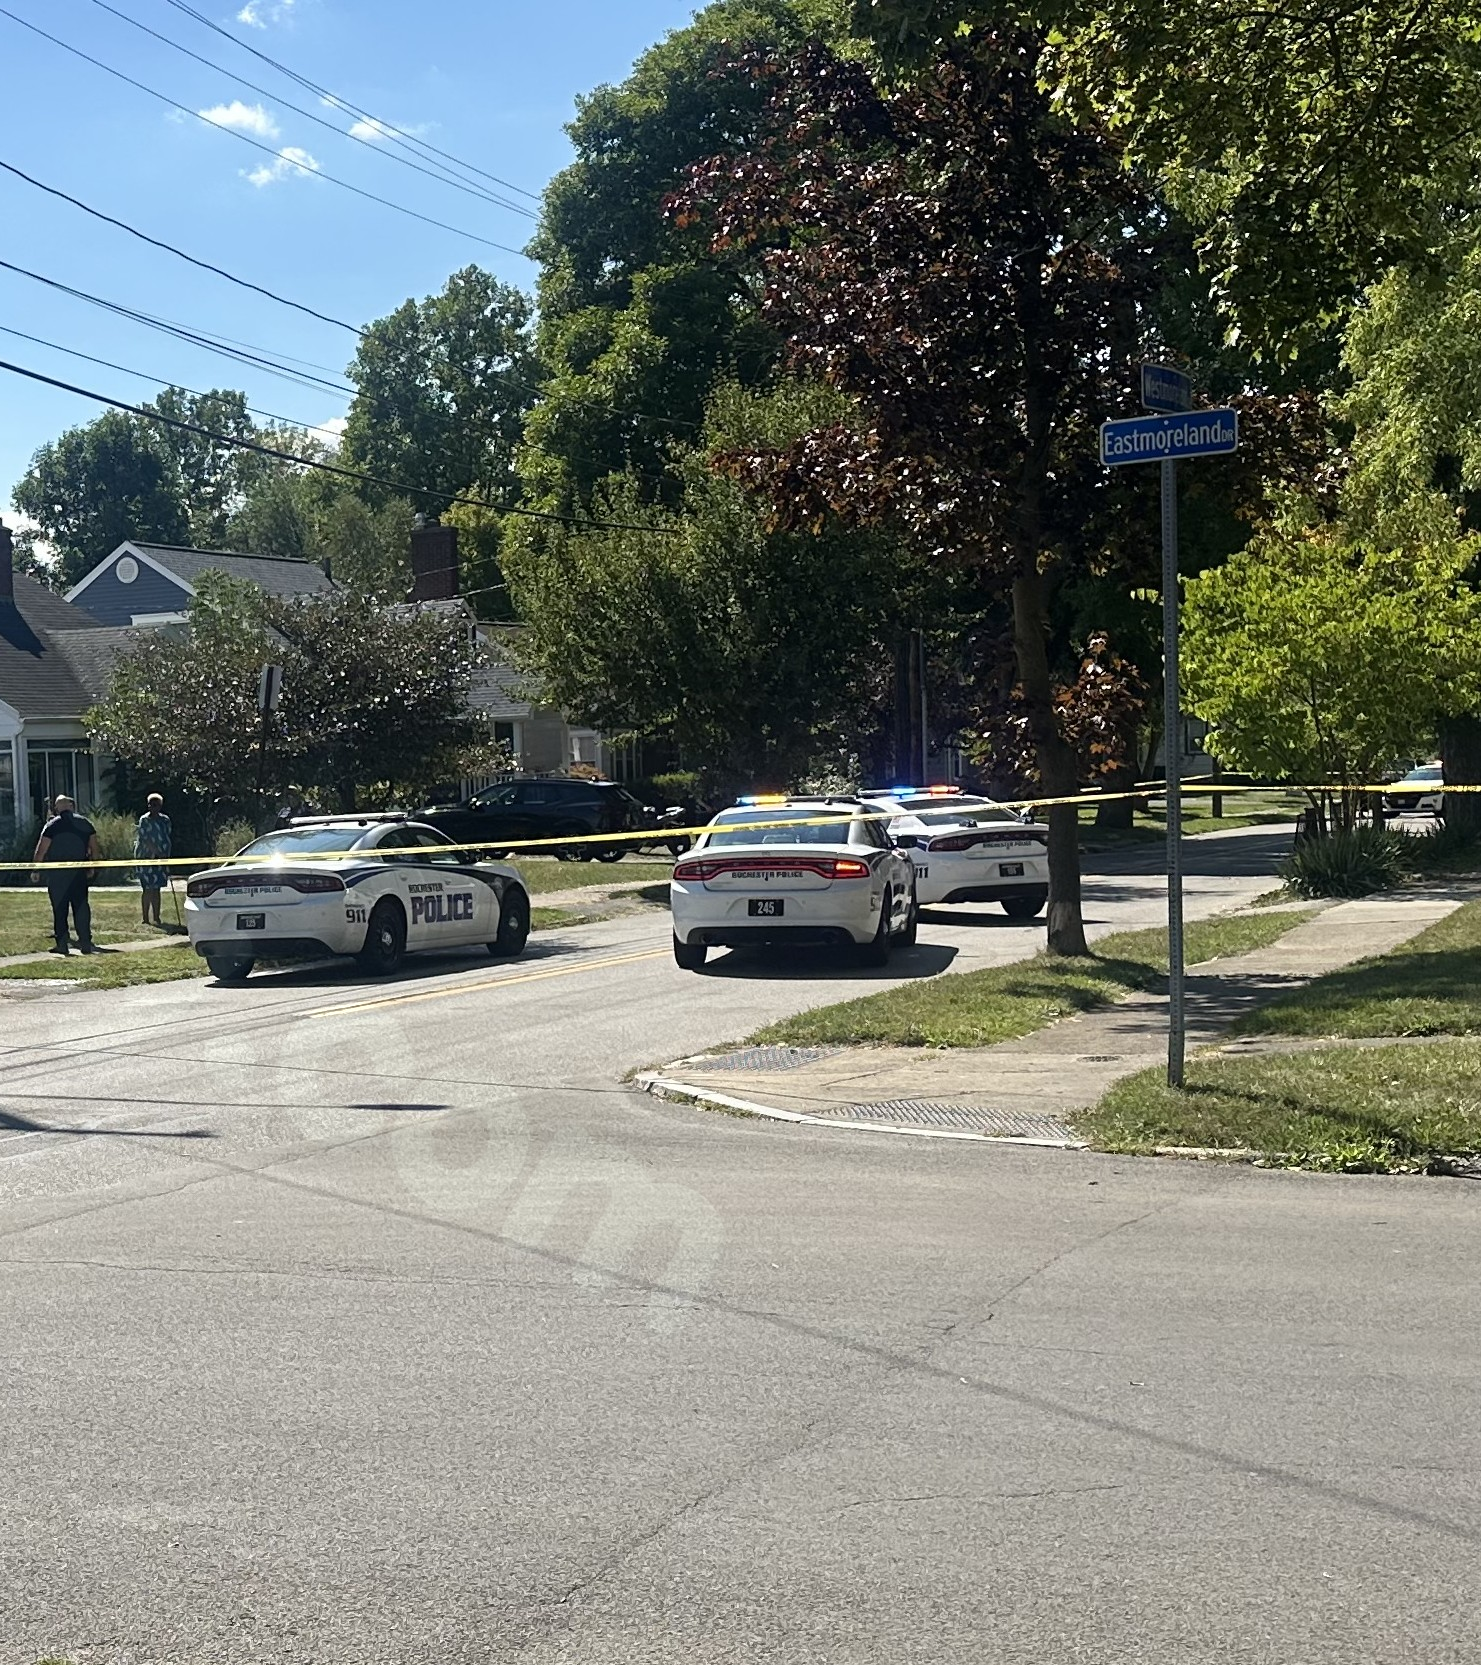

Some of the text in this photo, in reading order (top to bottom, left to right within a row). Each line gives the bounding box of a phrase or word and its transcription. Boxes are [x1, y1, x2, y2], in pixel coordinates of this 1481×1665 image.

[1104, 420, 1234, 456] Eastmoreland DR
[346, 909, 367, 924] 911
[411, 893, 473, 924] POLICE
[757, 901, 775, 915] 245
